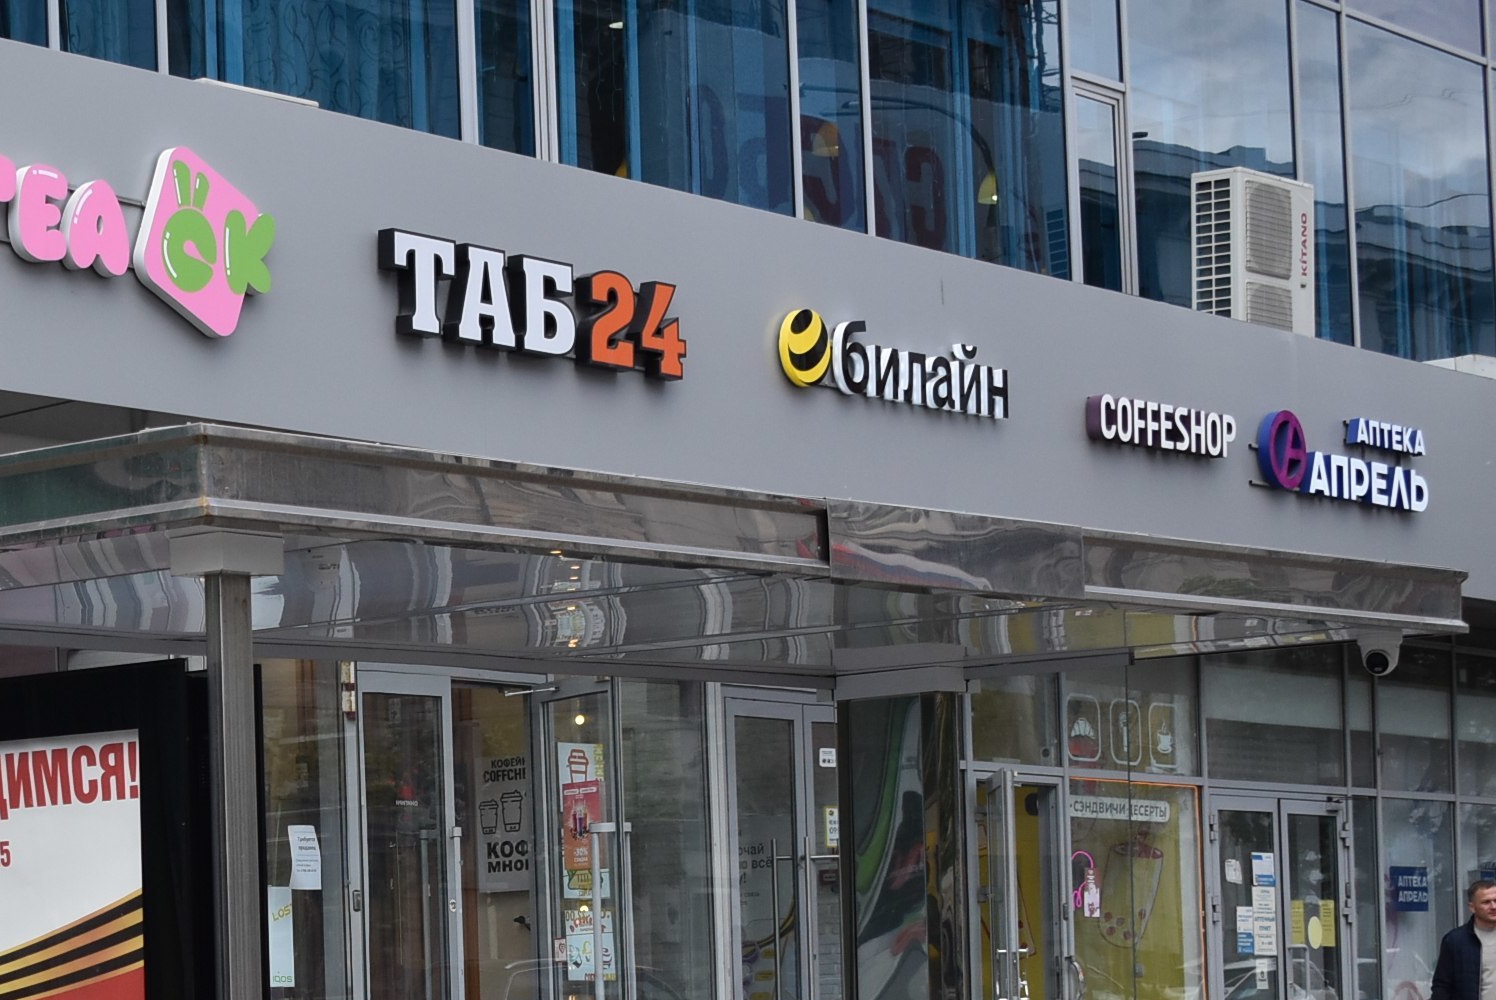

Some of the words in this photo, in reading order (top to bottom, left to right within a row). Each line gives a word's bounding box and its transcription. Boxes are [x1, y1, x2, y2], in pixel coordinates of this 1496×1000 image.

[833, 320, 1009, 420] билайн
[1092, 393, 1237, 459] COFFESHOP
[1352, 417, 1427, 457] АПТЕКА
[1307, 451, 1430, 512] АПРЕЛЬ
[1073, 800, 1126, 815] СЭНДВИЧИ
[487, 839, 529, 859] КОФ
[1397, 875, 1427, 887] АПТЕКА
[1398, 890, 1428, 903] АПРЕЛЬ
[272, 903, 292, 922] LOS
[272, 975, 293, 984] IQOS
